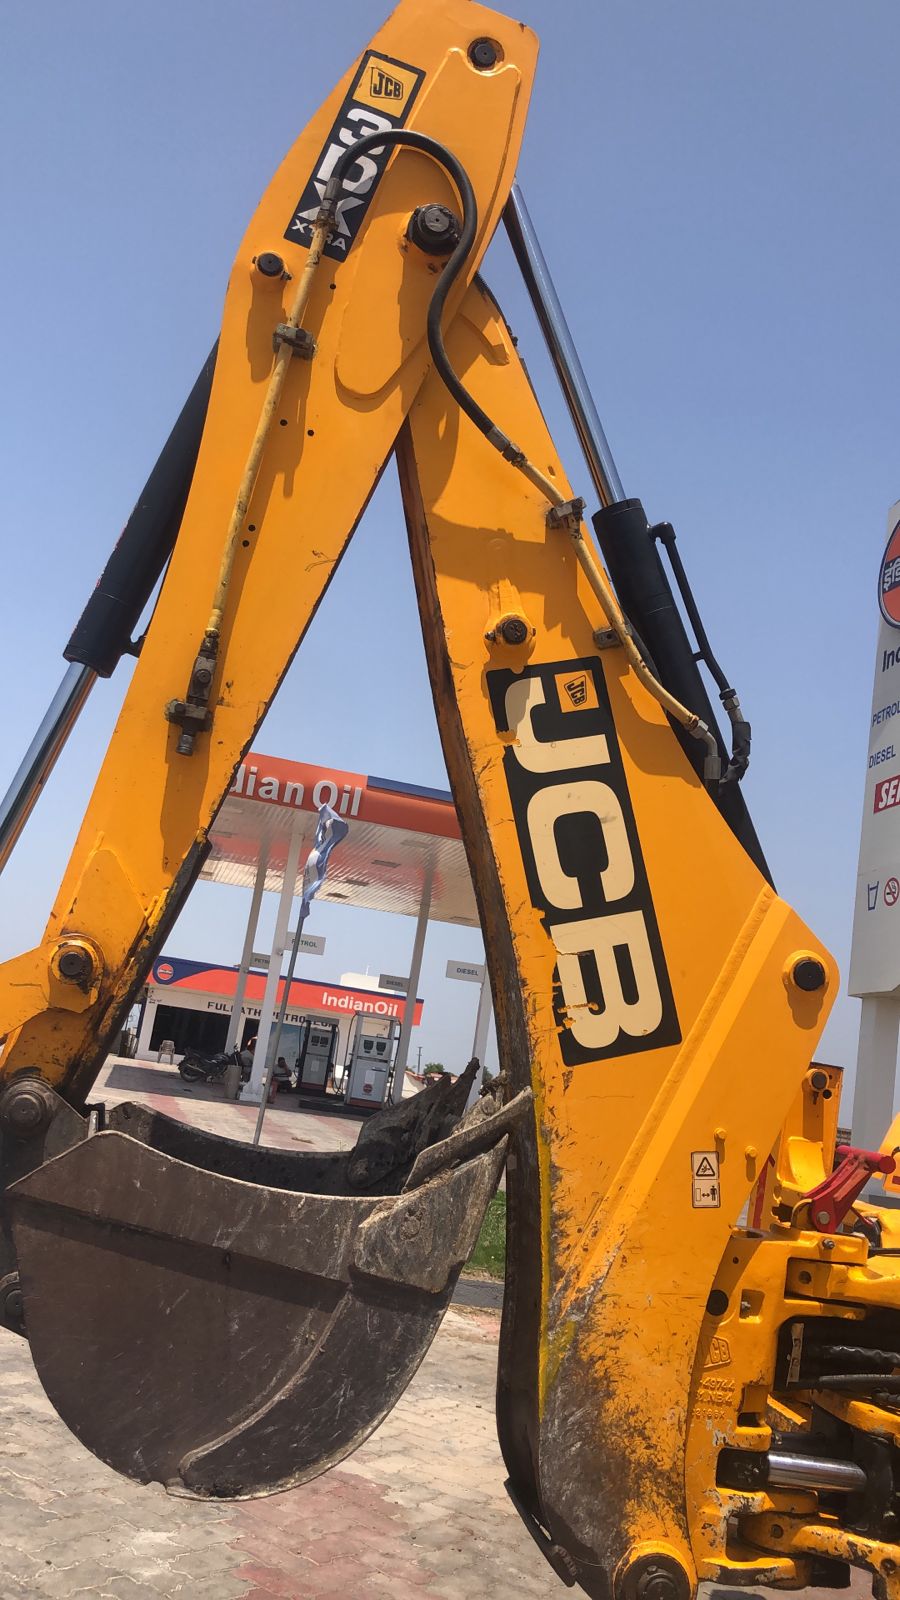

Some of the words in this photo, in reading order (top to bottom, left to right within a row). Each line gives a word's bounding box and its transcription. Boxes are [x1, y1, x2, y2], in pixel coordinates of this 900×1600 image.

[372, 71, 402, 98] JCB
[566, 680, 586, 705] JCB
[868, 745, 896, 769] DIESEL
[504, 676, 663, 1049] JCB
[456, 967, 479, 977] DIESEL
[321, 991, 399, 1017] IndianOil
